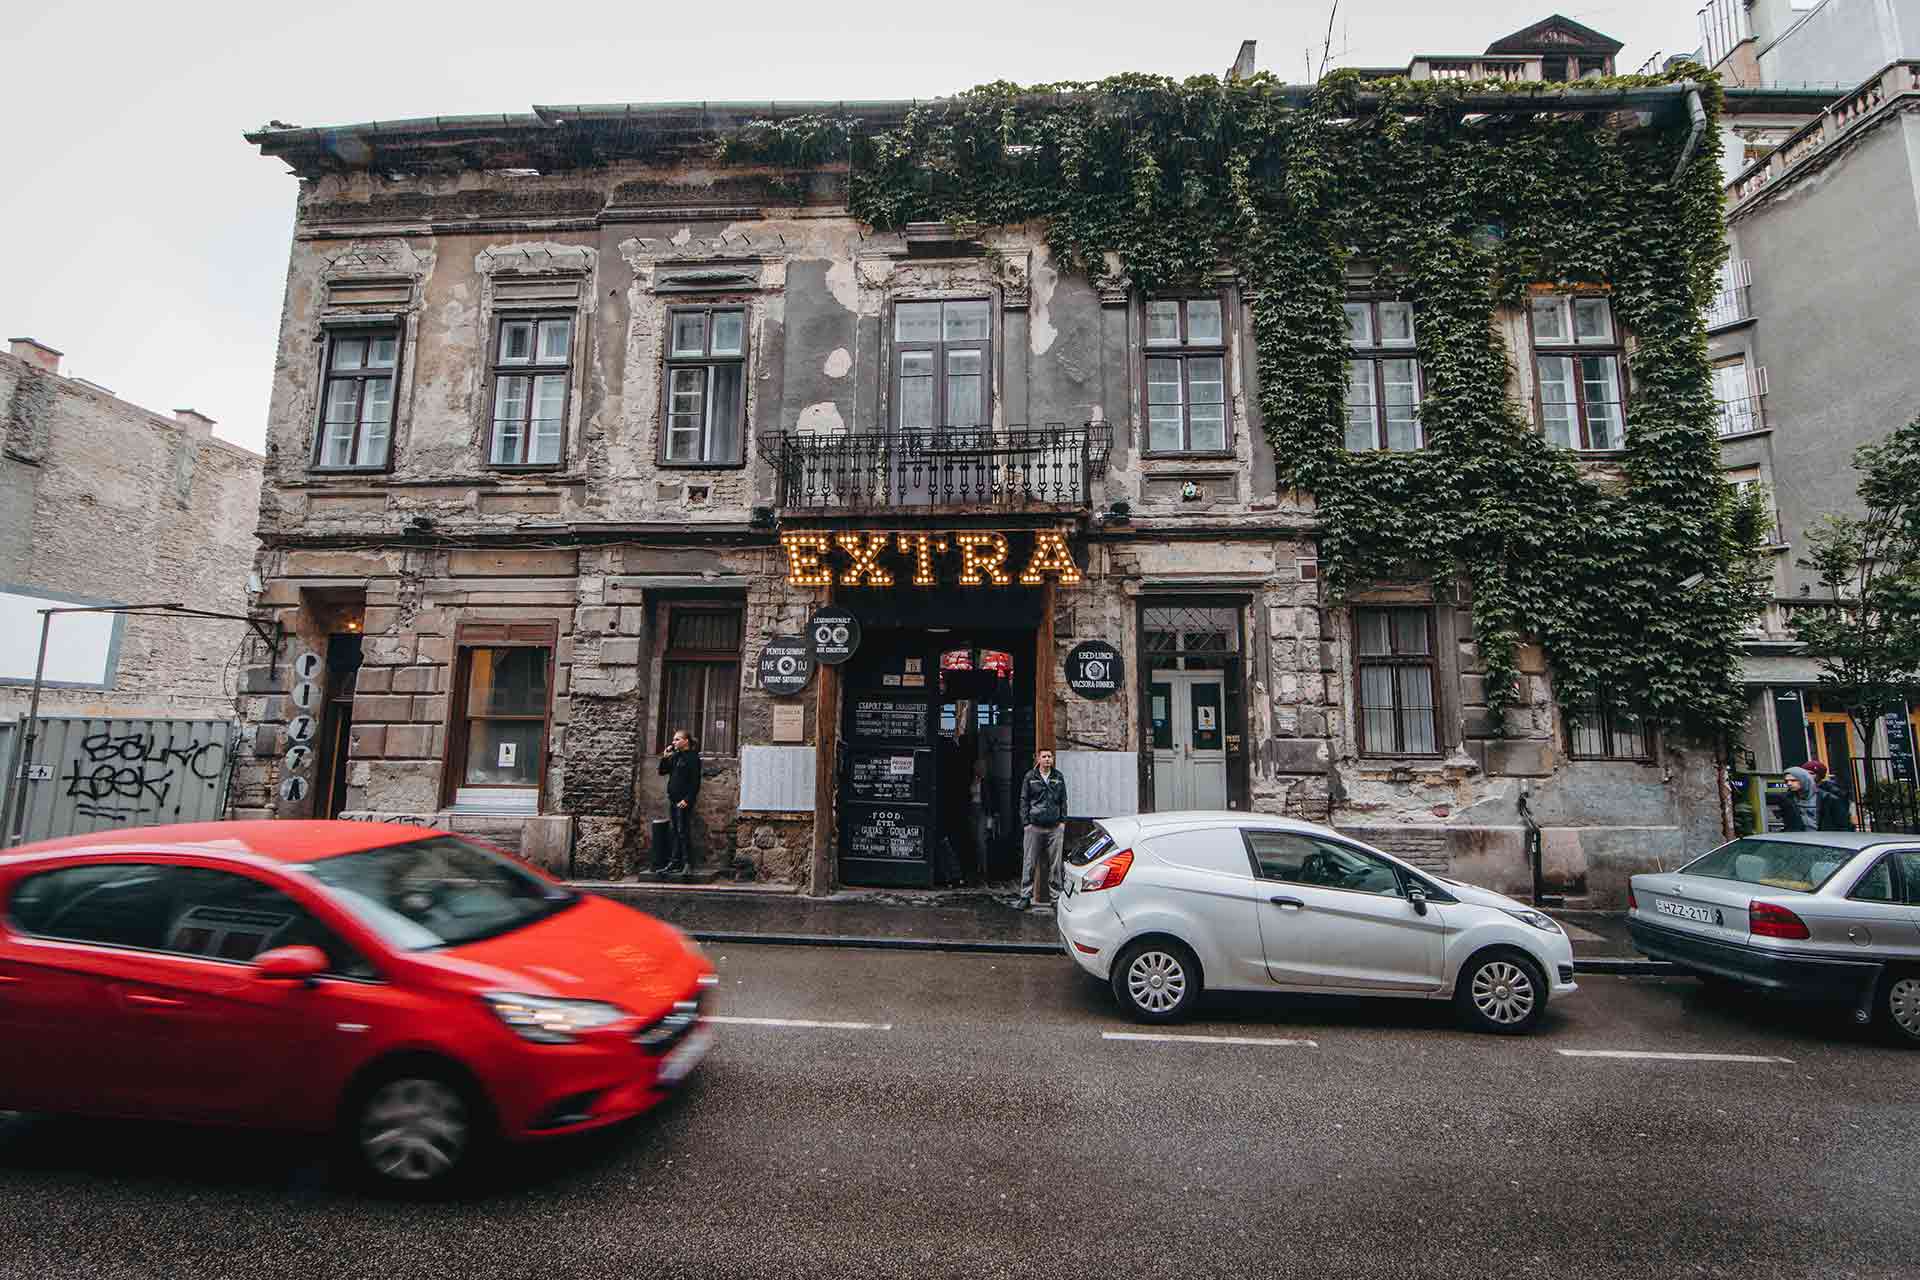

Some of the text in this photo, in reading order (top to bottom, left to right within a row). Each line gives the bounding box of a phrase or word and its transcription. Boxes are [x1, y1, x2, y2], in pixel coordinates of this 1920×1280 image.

[780, 531, 1081, 585] EXTRA
[761, 660, 808, 671] LIVE DJ
[286, 654, 318, 801] PIZZA
[872, 811, 901, 820] FOOD
[1663, 903, 1710, 921] HZZ-217
